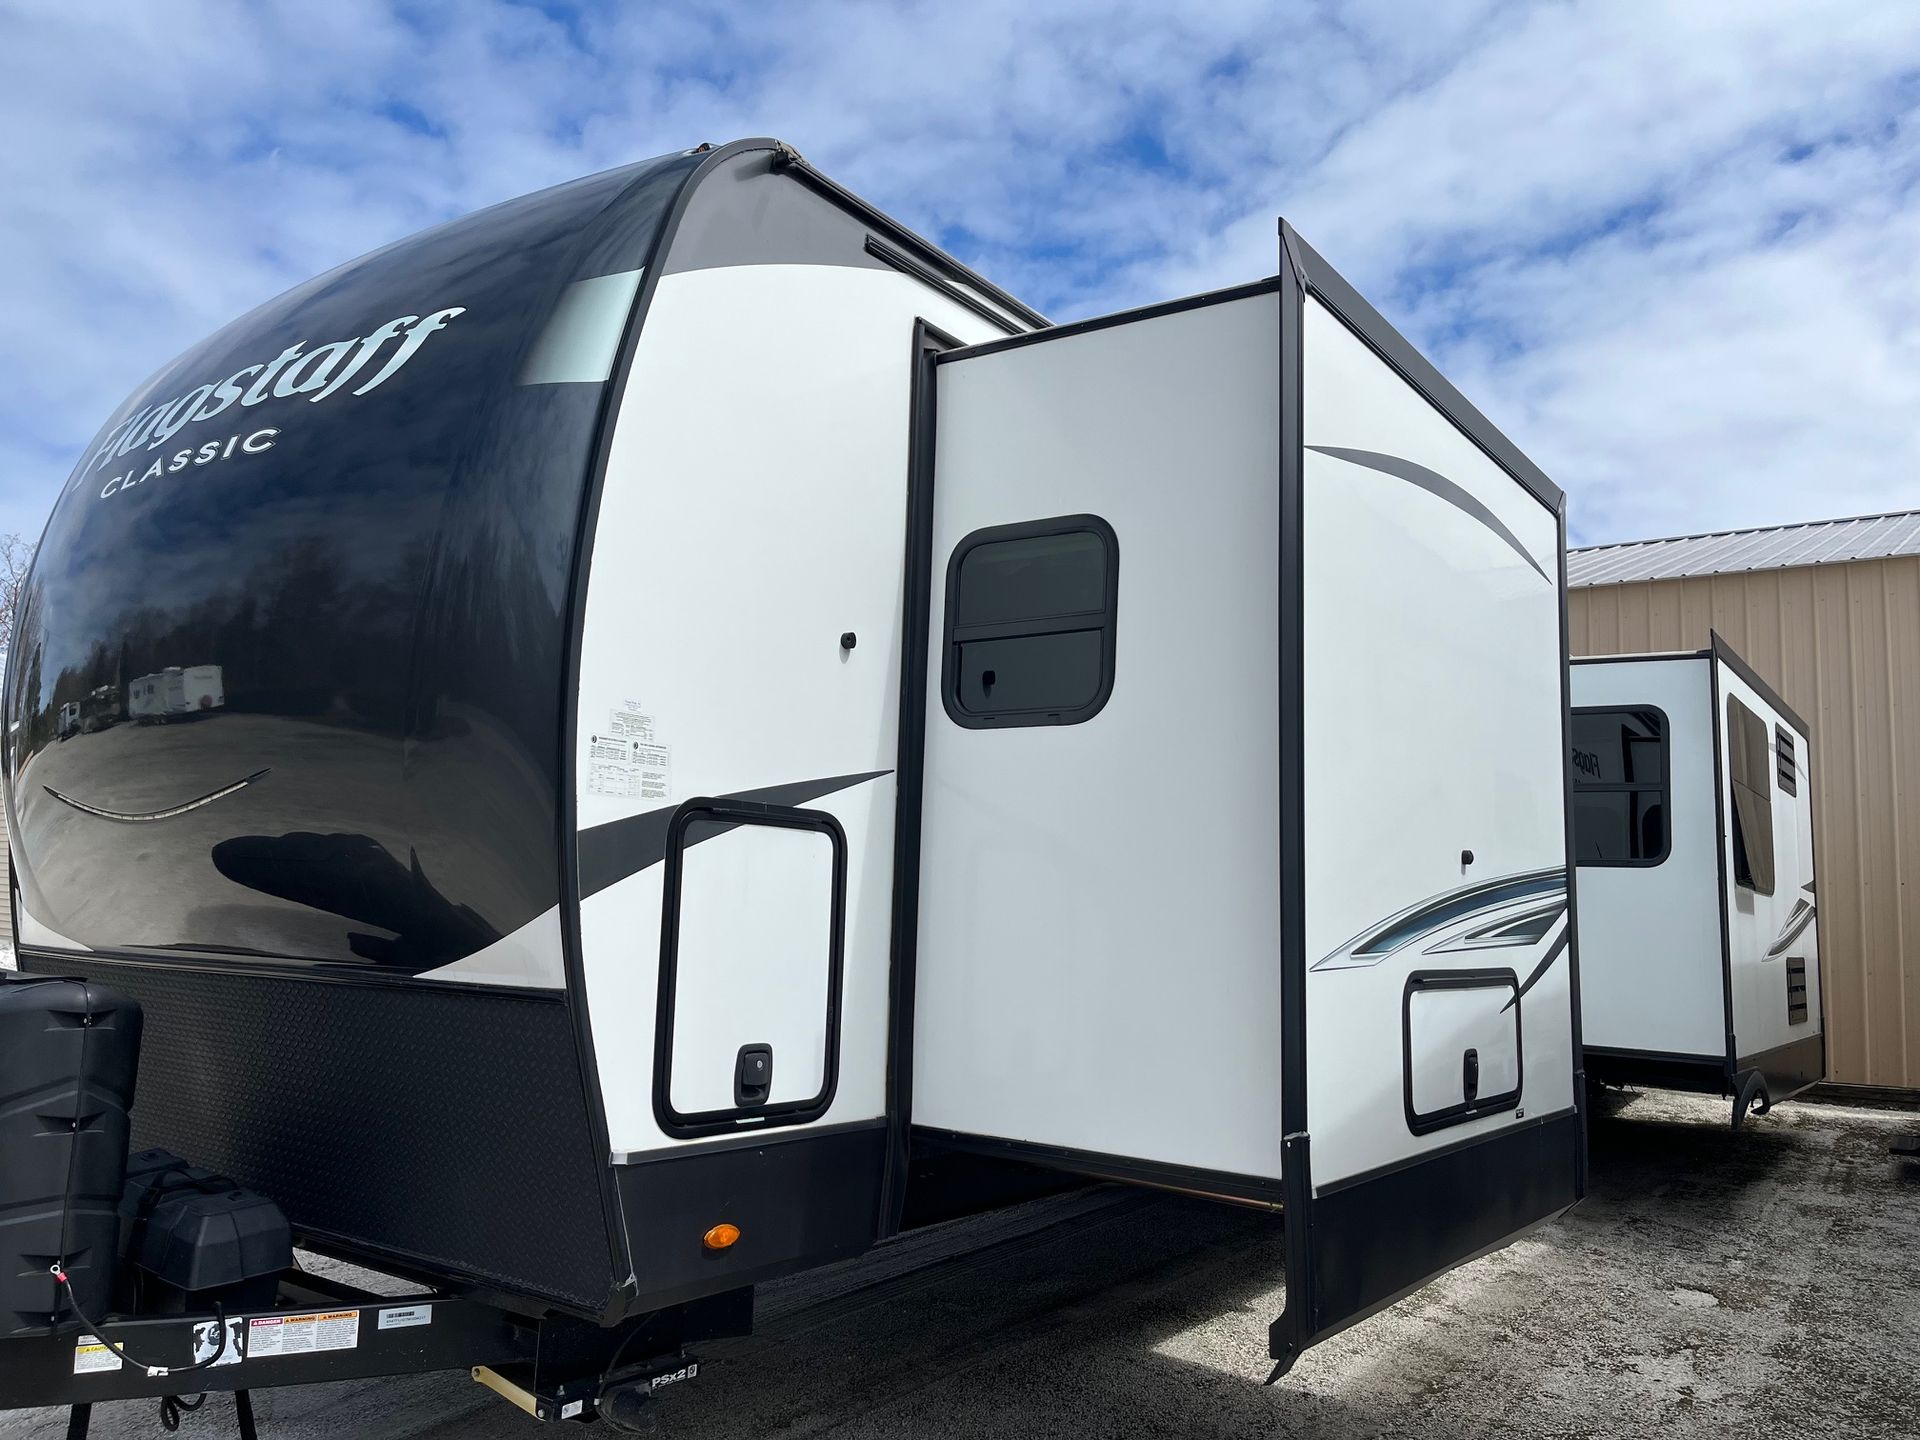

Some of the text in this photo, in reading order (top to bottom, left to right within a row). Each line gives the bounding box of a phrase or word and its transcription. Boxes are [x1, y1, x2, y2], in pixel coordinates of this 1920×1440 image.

[71, 306, 467, 492] Flagstaff
[99, 427, 283, 500] CLASSIC
[652, 1369, 686, 1387] PSx2
